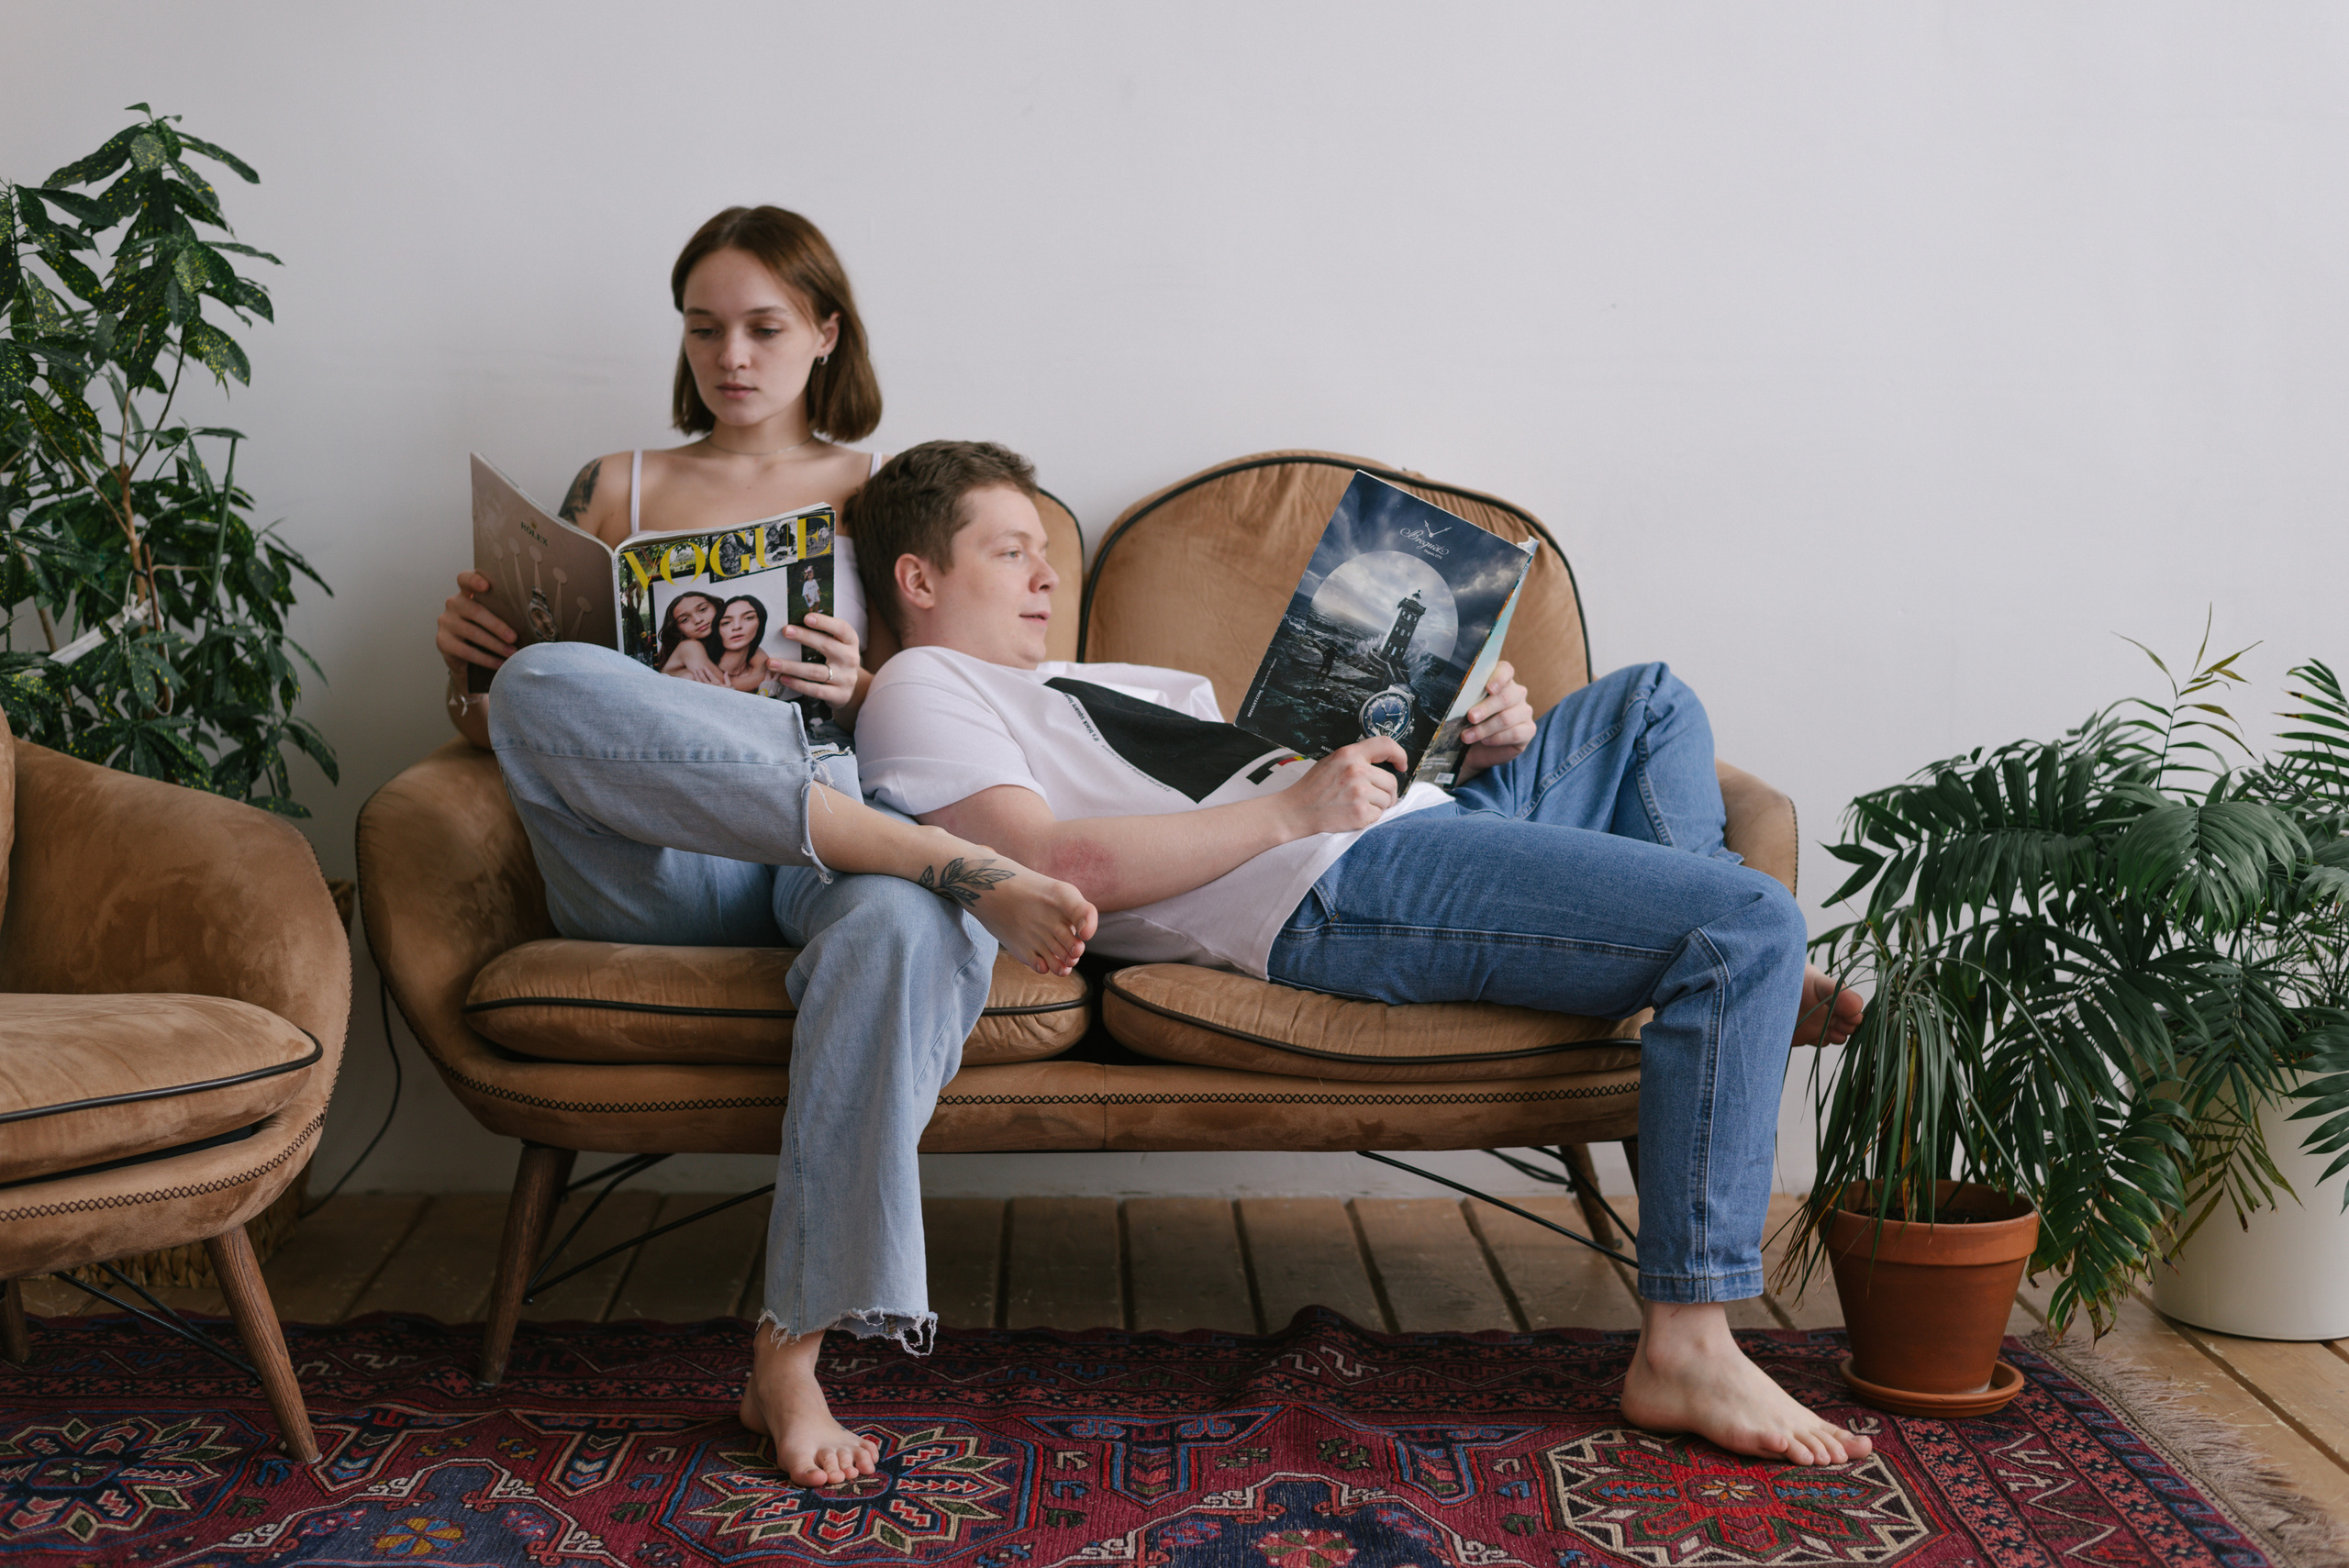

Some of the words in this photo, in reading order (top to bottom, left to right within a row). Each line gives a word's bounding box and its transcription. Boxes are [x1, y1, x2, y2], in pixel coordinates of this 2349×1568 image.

[520, 521, 549, 547] ROLEX
[1399, 528, 1450, 556] Breguet
[620, 515, 831, 592] VOGUE
[1072, 704, 1085, 720] square
[1083, 720, 1094, 734] black
